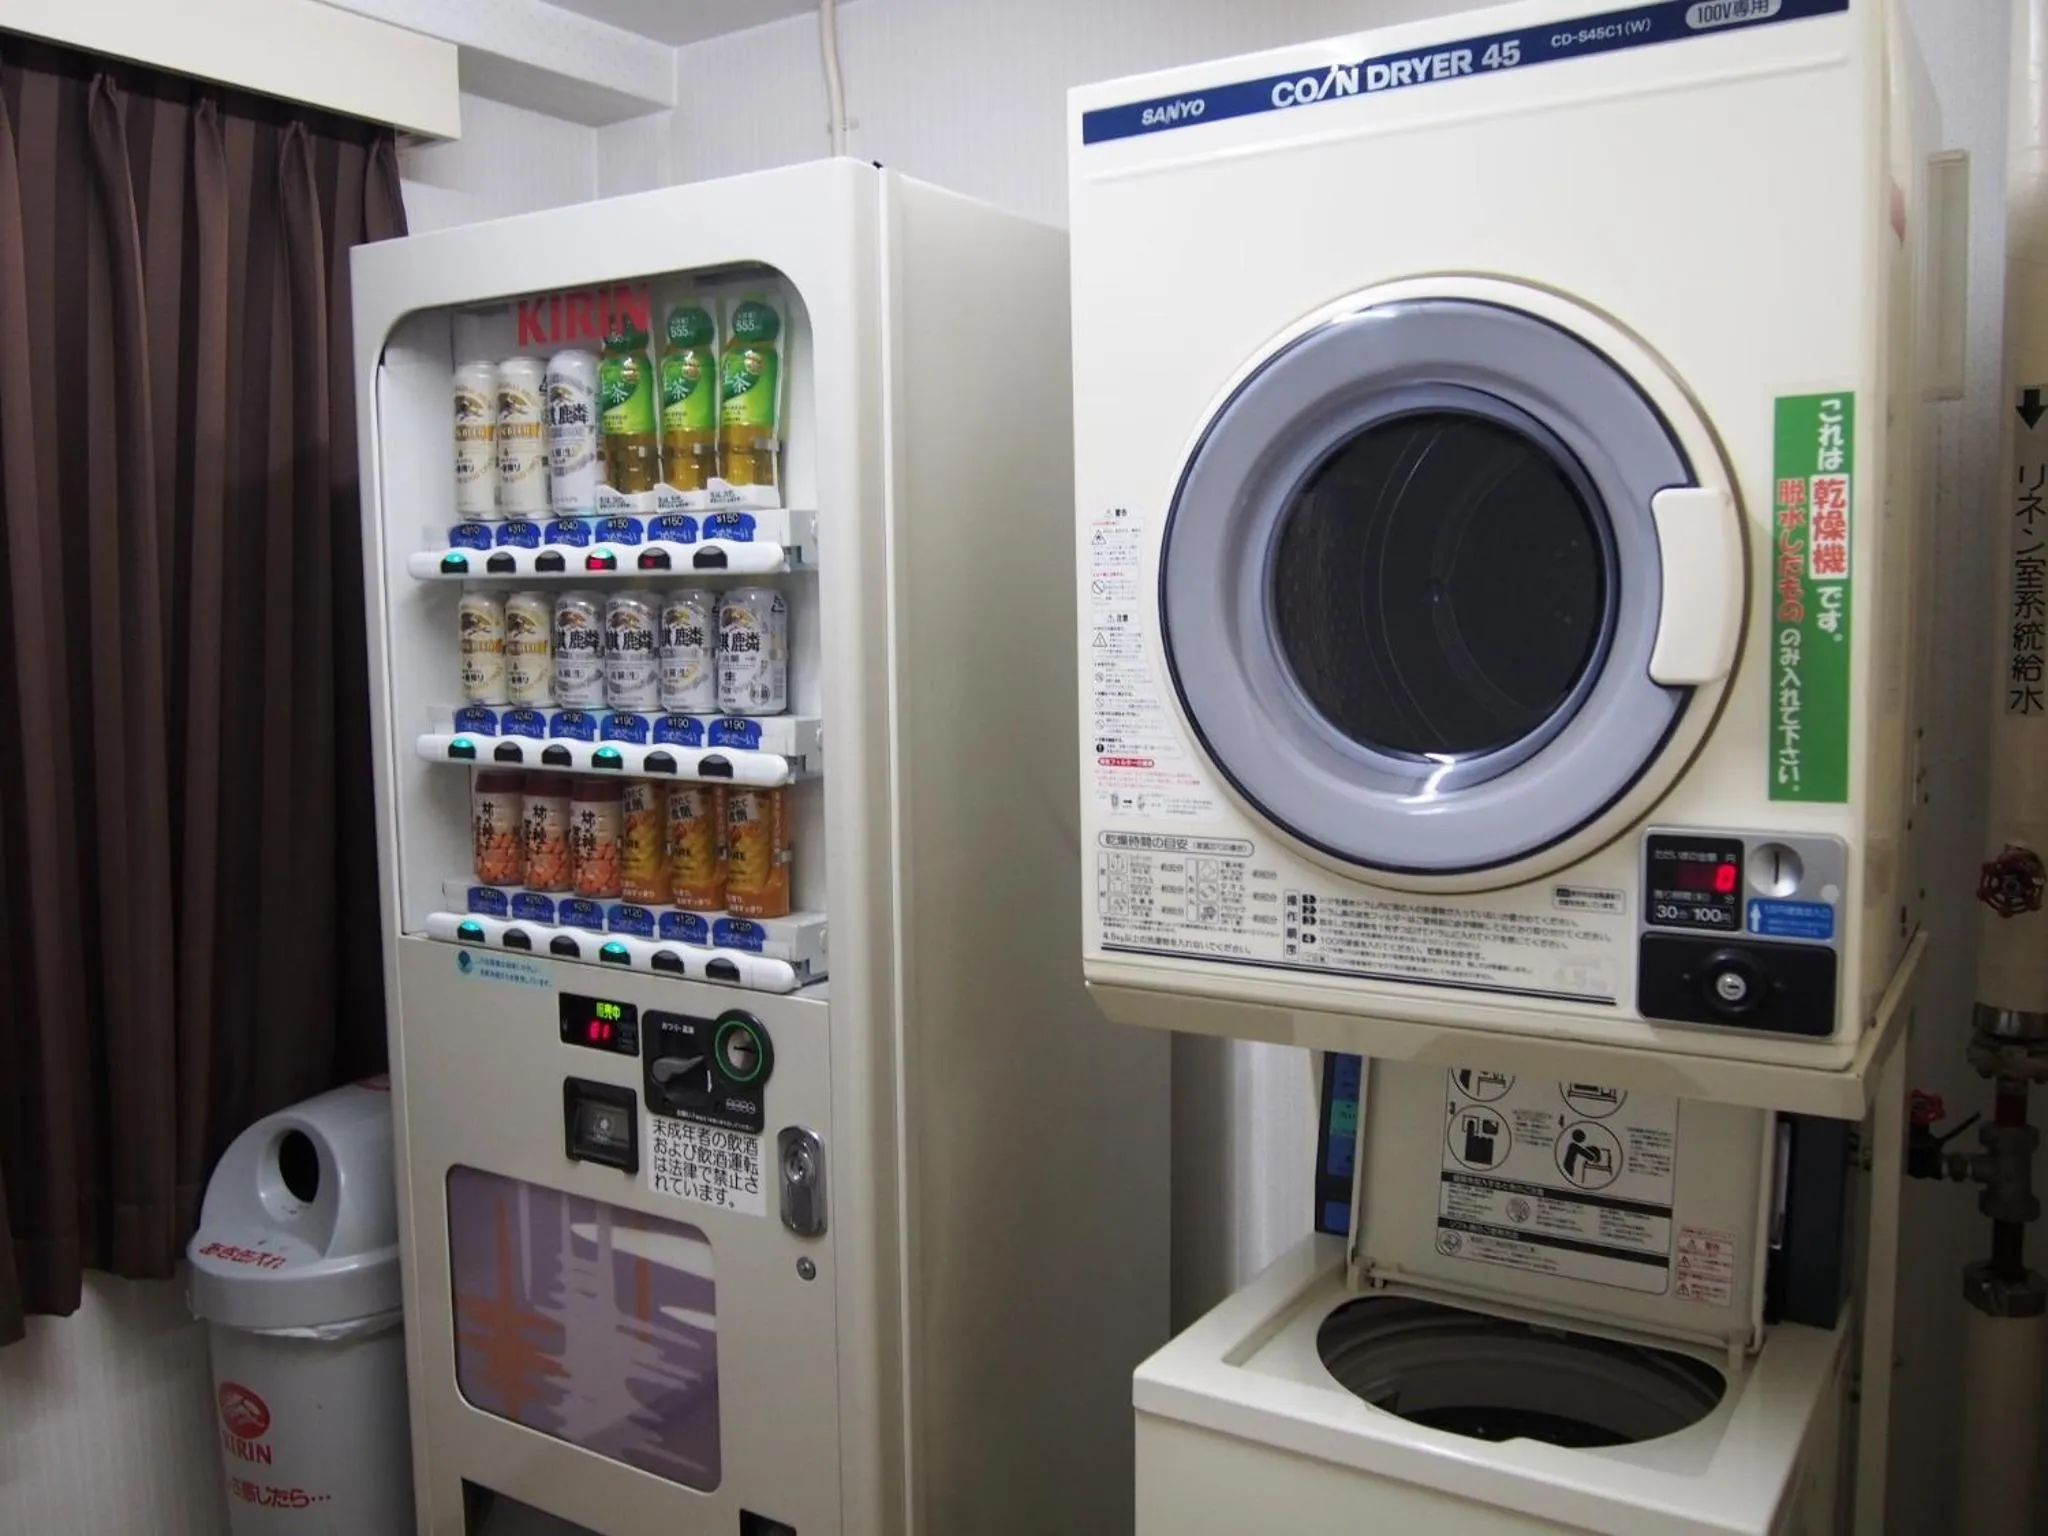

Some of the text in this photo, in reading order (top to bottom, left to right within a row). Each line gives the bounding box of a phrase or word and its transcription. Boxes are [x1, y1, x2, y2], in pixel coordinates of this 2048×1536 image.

[1271, 40, 1521, 109] COIN DRYER 45
[1142, 100, 1205, 127] SANYO
[517, 283, 651, 347] KIRIN
[2011, 463, 2047, 715] リネン室系統給水
[653, 1119, 759, 1154] 未成年者の飲酒
[653, 1137, 759, 1176] および飲酒運転
[653, 1157, 759, 1194] は法律で禁止さ
[655, 1173, 735, 1208] れています。
